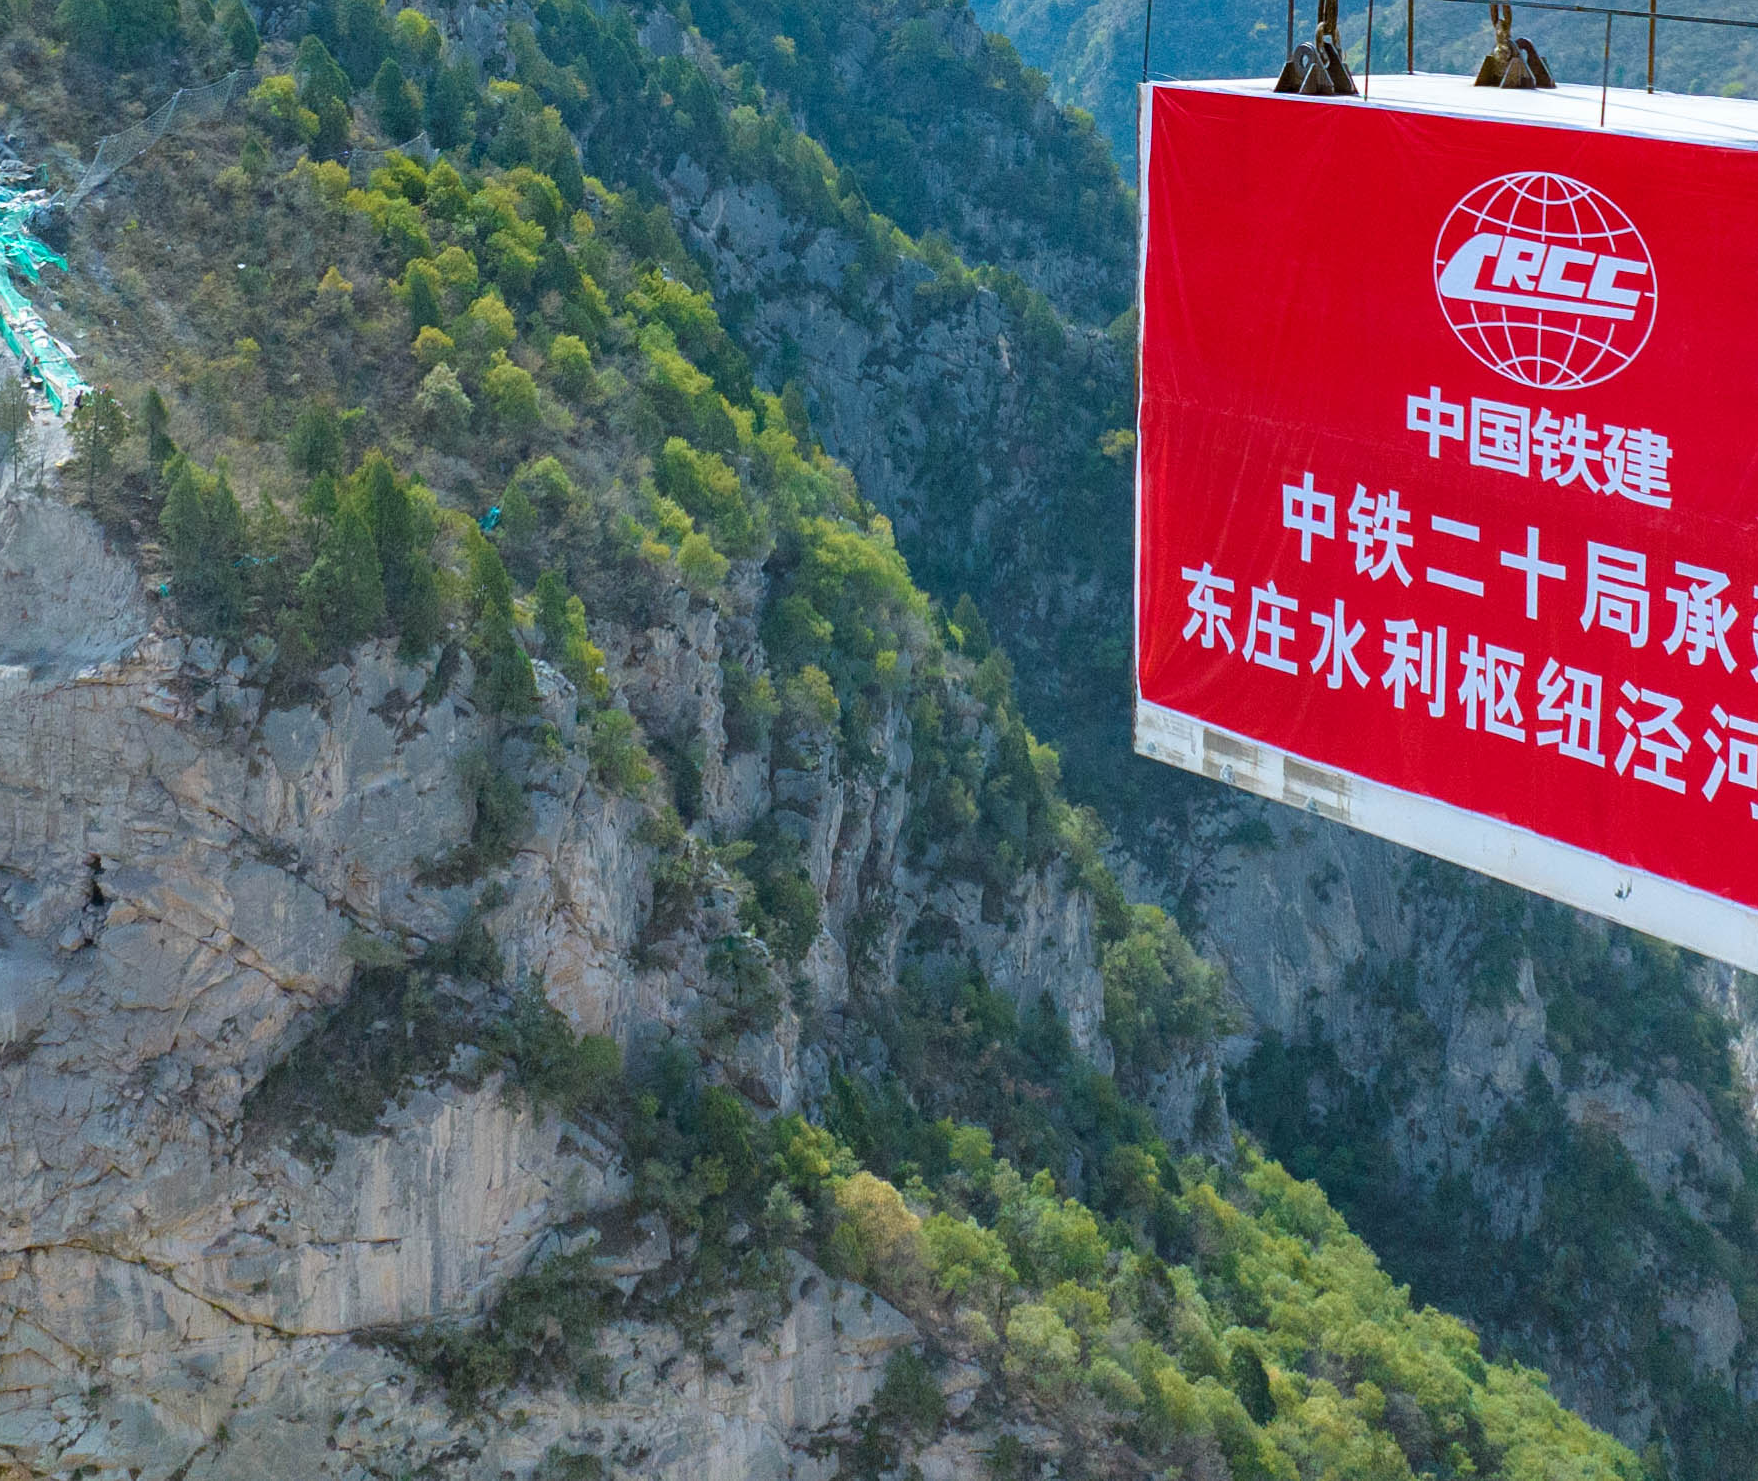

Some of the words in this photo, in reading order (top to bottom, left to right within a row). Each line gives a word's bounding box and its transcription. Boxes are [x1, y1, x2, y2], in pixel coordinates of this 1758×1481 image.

[1439, 232, 1649, 321] CRCC
[1407, 386, 1673, 510] 中国铁建
